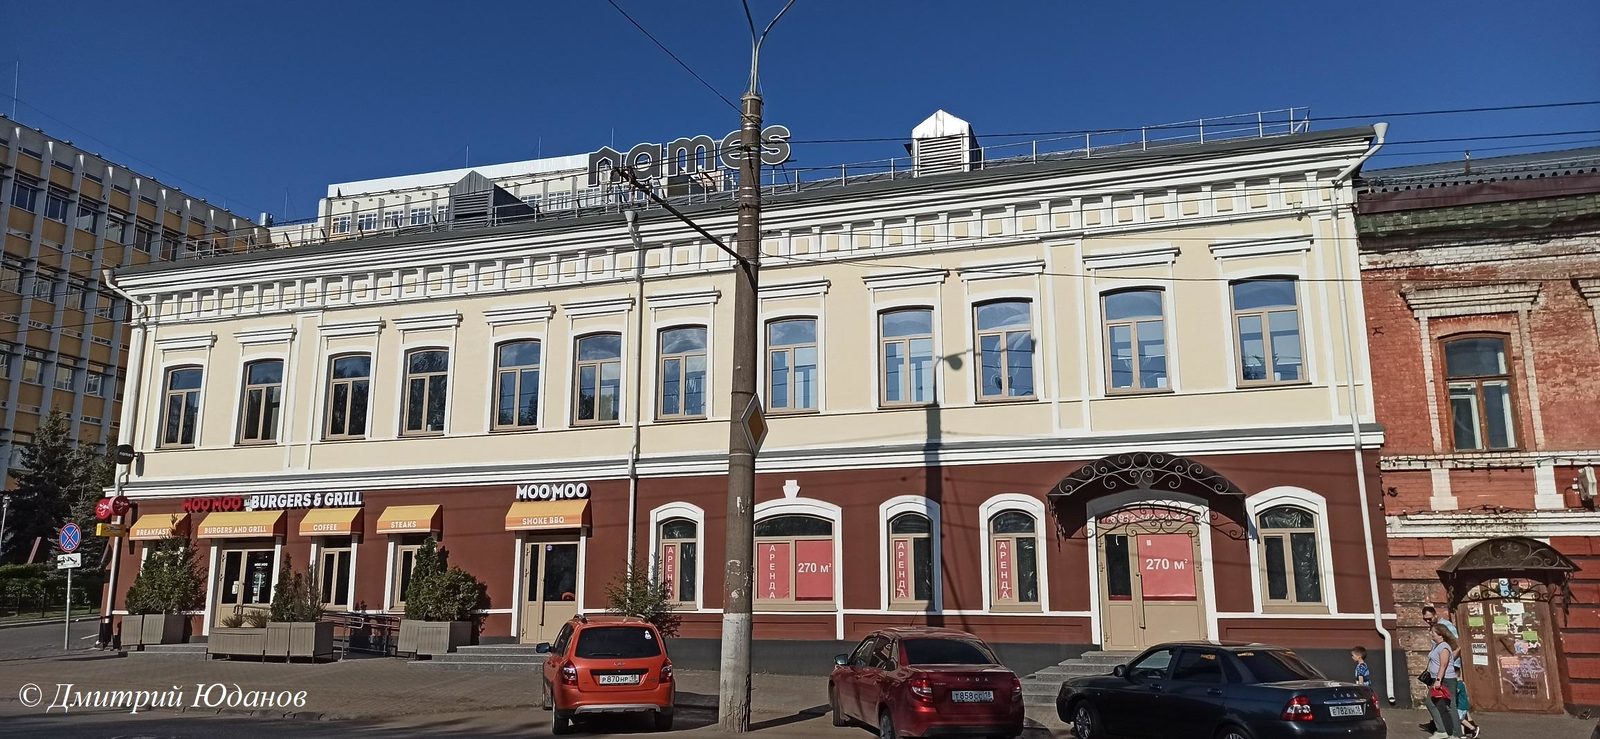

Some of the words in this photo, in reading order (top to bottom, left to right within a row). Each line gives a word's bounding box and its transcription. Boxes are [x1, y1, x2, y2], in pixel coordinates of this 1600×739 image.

[587, 125, 791, 187] names
[516, 484, 550, 499] MOO
[552, 483, 588, 498] MOO
[183, 498, 210, 512] MOO
[212, 496, 241, 511] MOO
[251, 493, 311, 509] BURGERS
[313, 493, 322, 506] &
[324, 491, 362, 506] GRILL
[390, 521, 417, 529] STEAKS
[522, 517, 548, 525] SMOKE
[549, 516, 565, 524] BBQ
[136, 528, 170, 536] BREAKFAST
[204, 526, 233, 534] BURGERS
[233, 526, 248, 534] AND
[248, 525, 267, 533] GRILL
[798, 562, 817, 573] 270
[897, 542, 906, 598] АРЕНДА
[1146, 558, 1170, 570] 270
[999, 542, 1009, 599] АРЕНДА
